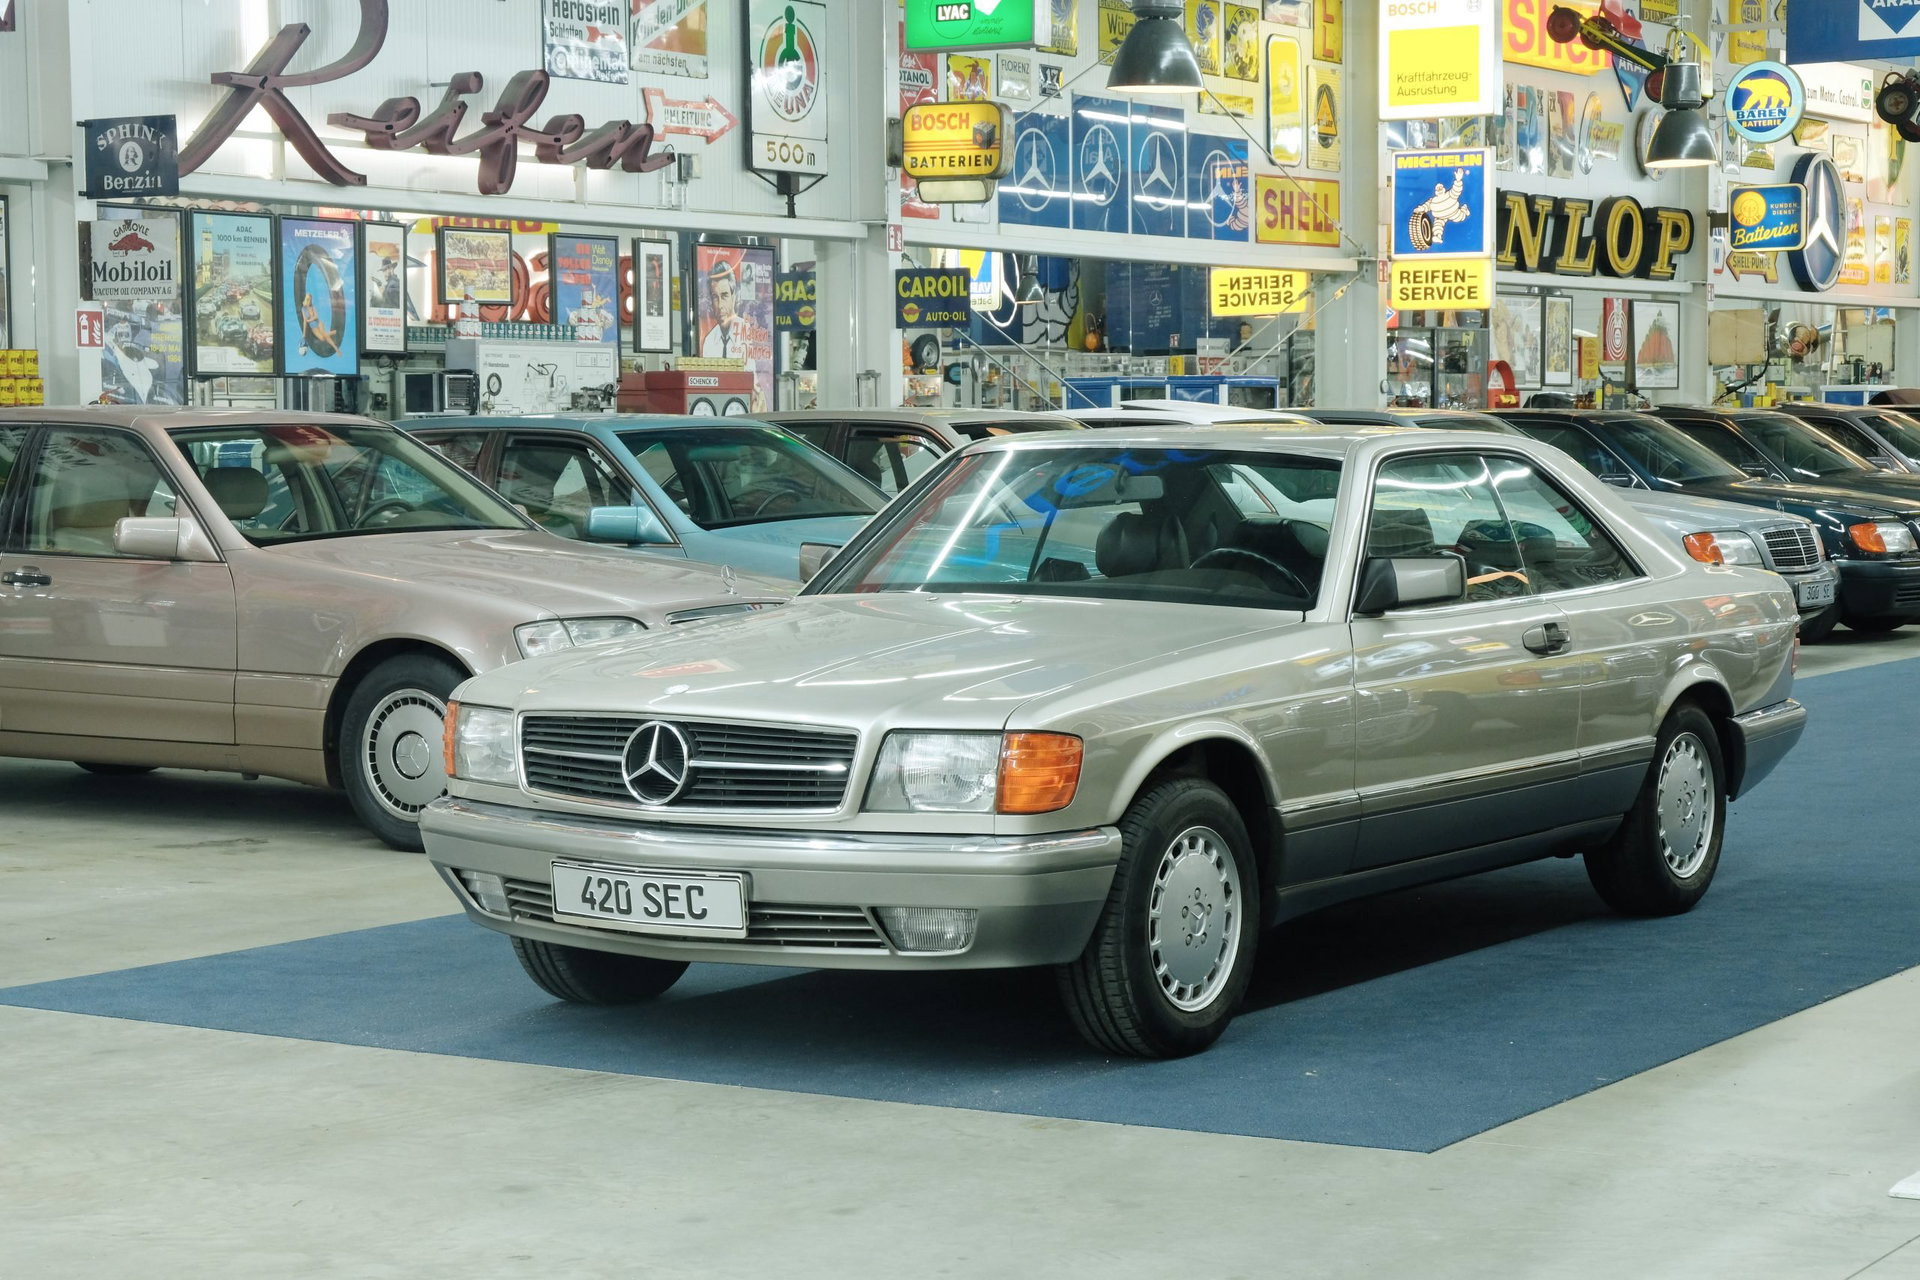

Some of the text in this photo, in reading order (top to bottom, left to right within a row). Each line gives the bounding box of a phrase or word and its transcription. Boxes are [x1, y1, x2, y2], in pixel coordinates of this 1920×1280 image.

[937, 5, 969, 21] LYAC
[1388, 1, 1436, 16] BOSCH
[1742, 7, 1761, 22] HELLA
[1001, 58, 1030, 75] FLORENZ
[1397, 71, 1472, 83] Kraftfahrzeug-
[176, 0, 676, 195] Reifen
[664, 108, 713, 127] UMLEITUNG
[911, 112, 970, 131] BOSCH
[1736, 108, 1787, 120] BÄREN
[1741, 119, 1782, 128] BATTERIE
[767, 141, 804, 165] 500
[910, 154, 993, 169] BATTERIEN
[1397, 154, 1482, 169] MICHELIN
[104, 170, 162, 191] Benzin
[1264, 188, 1334, 233] SHELL
[236, 225, 253, 233] ADAC
[294, 229, 341, 239] METZELER
[1497, 190, 1694, 280] NLOP
[1733, 222, 1798, 246] Batterien
[93, 260, 172, 283] Mobiloil
[94, 286, 119, 296] VACUUM
[130, 286, 161, 296] COMPANY
[898, 275, 968, 298] CAROIL
[1399, 285, 1478, 301] SERVICE
[689, 377, 713, 386] SCHENCK
[1806, 583, 1831, 601] 300 SE
[581, 875, 708, 920] 420 SEC
